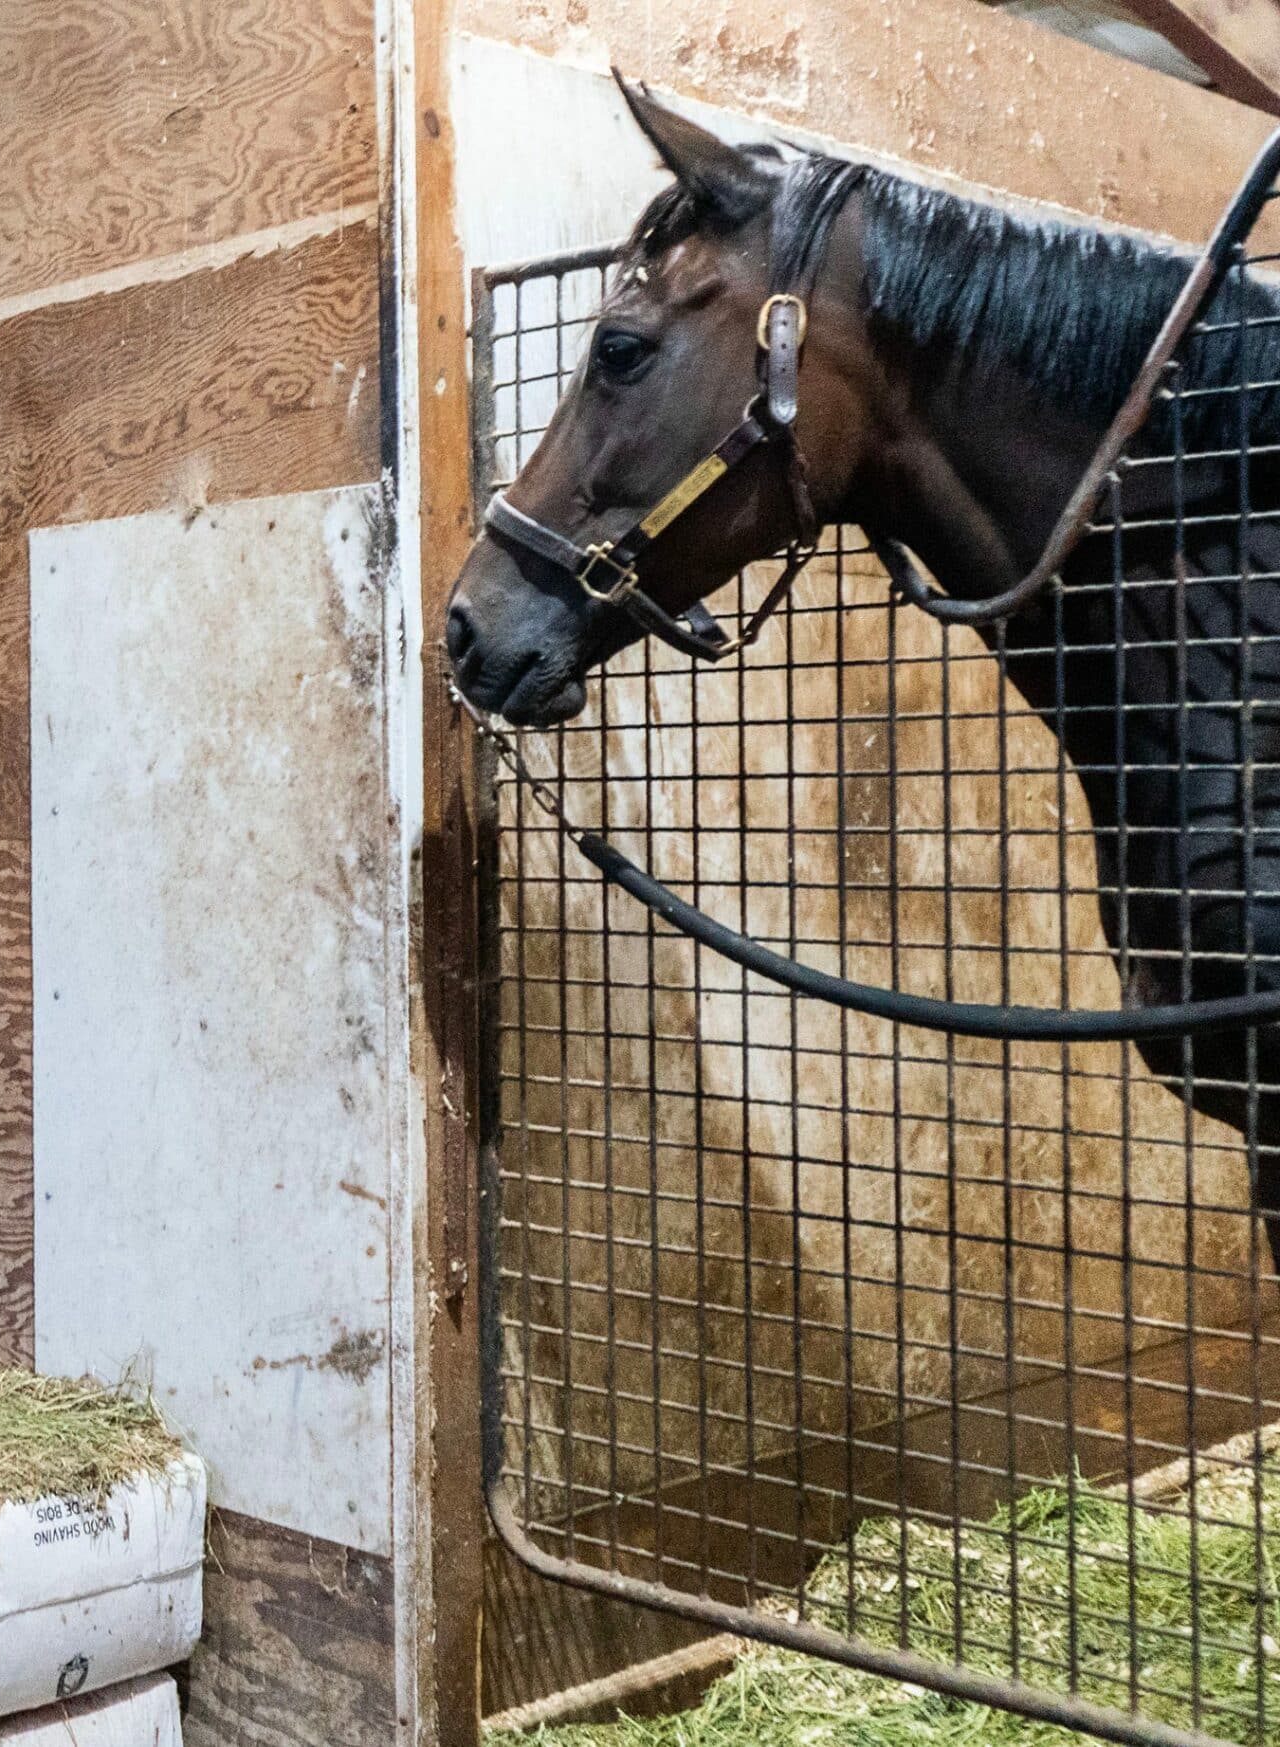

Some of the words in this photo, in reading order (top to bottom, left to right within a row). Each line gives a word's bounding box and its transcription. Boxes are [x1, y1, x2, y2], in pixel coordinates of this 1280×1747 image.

[36, 1505, 62, 1523] BOIS
[64, 1500, 80, 1517] DE
[34, 1523, 80, 1547] SHAVING
